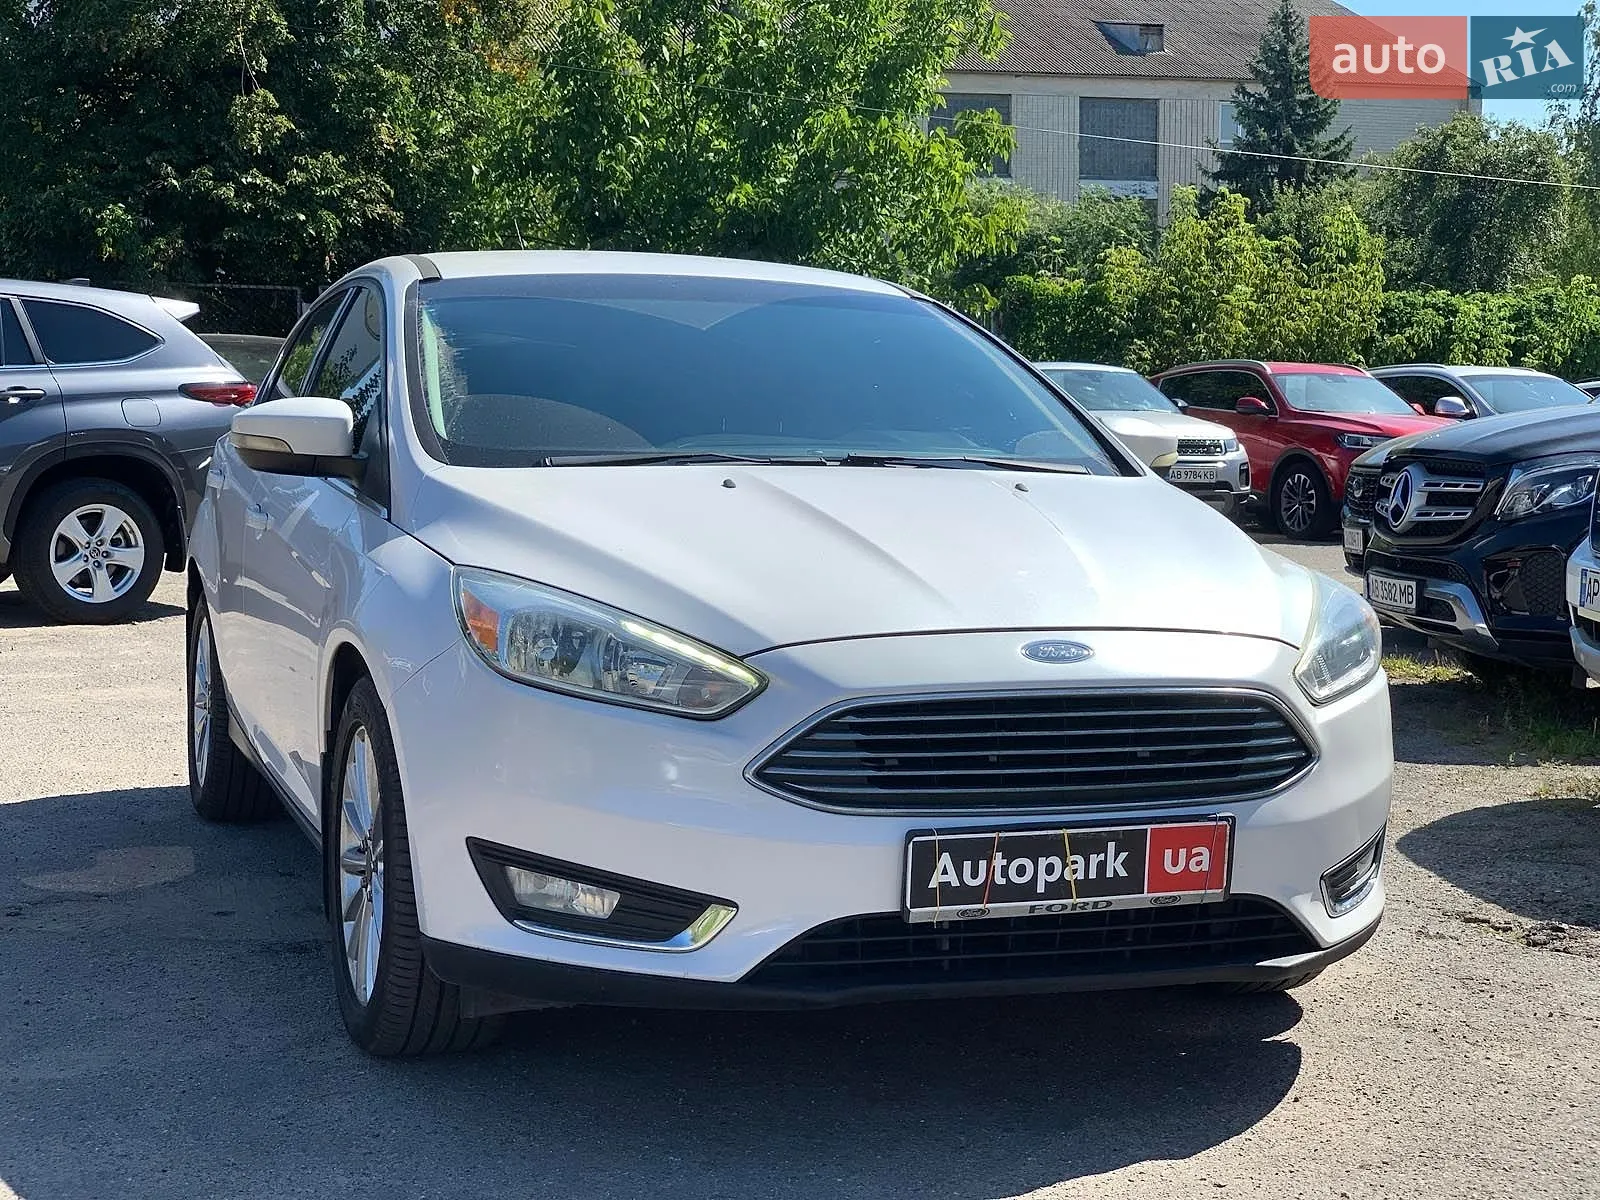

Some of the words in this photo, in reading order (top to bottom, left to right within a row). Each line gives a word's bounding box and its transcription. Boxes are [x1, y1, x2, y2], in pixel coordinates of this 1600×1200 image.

[1170, 470, 1182, 480] AB
[1183, 470, 1202, 480] 9784
[1203, 470, 1215, 480] KB
[1380, 580, 1398, 603] 3582
[1398, 583, 1414, 605] MB
[1586, 577, 1600, 605] AP
[928, 841, 1129, 894] Autopark
[1163, 846, 1211, 874] ua
[1028, 899, 1113, 915] FORD
